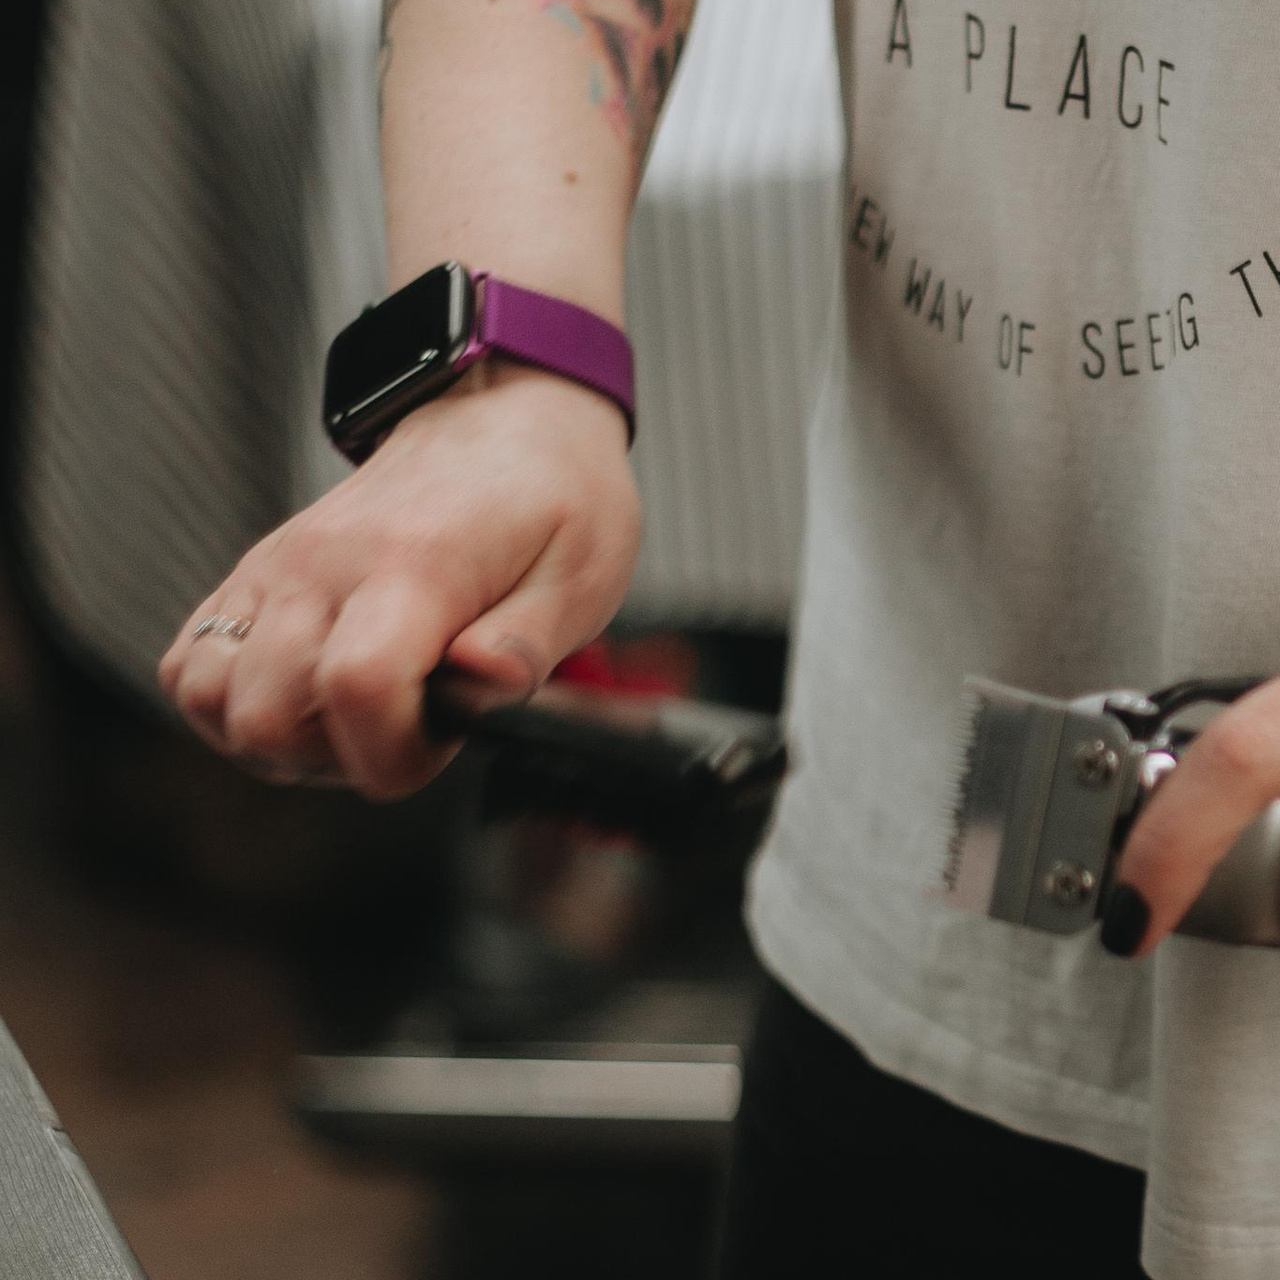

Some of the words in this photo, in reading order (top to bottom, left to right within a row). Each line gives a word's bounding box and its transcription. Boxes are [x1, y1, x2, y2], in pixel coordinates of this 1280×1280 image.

[963, 11, 1175, 146] PLACE
[904, 256, 974, 342] WAY
[997, 312, 1036, 377] OF
[1080, 291, 1200, 380] SEEG
